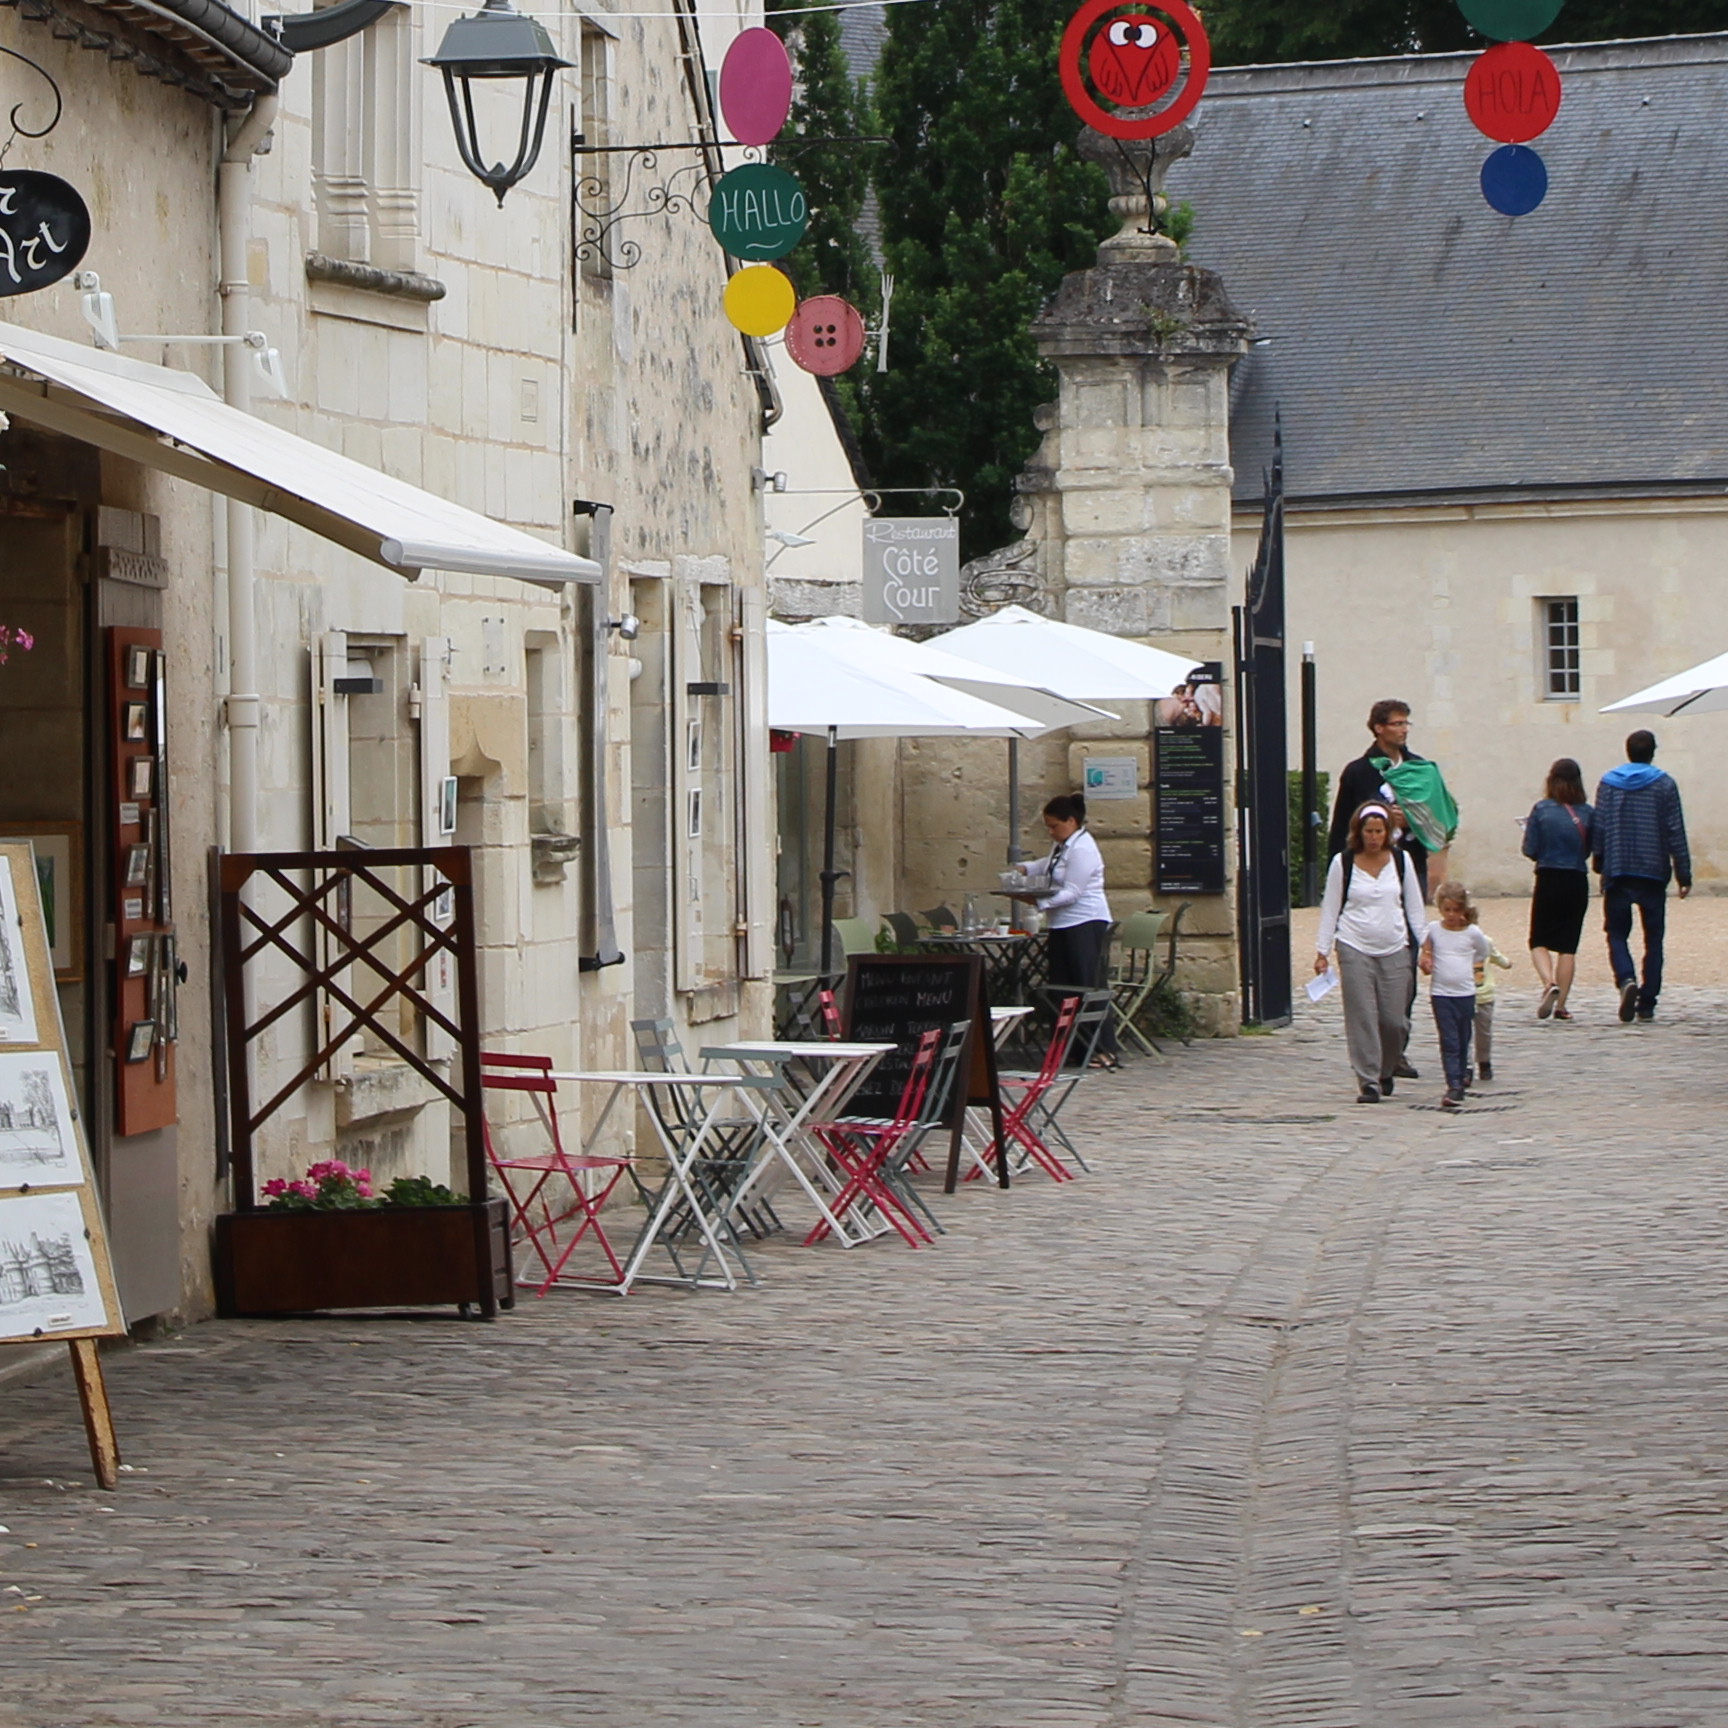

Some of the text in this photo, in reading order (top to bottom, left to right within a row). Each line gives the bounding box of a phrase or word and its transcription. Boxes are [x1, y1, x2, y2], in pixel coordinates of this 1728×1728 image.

[1477, 68, 1551, 116] HOLA
[720, 188, 806, 233] HALLO
[863, 521, 958, 544] Restaurant
[882, 545, 940, 588] Côté
[882, 580, 941, 621] Cour
[916, 988, 953, 1008] MENU
